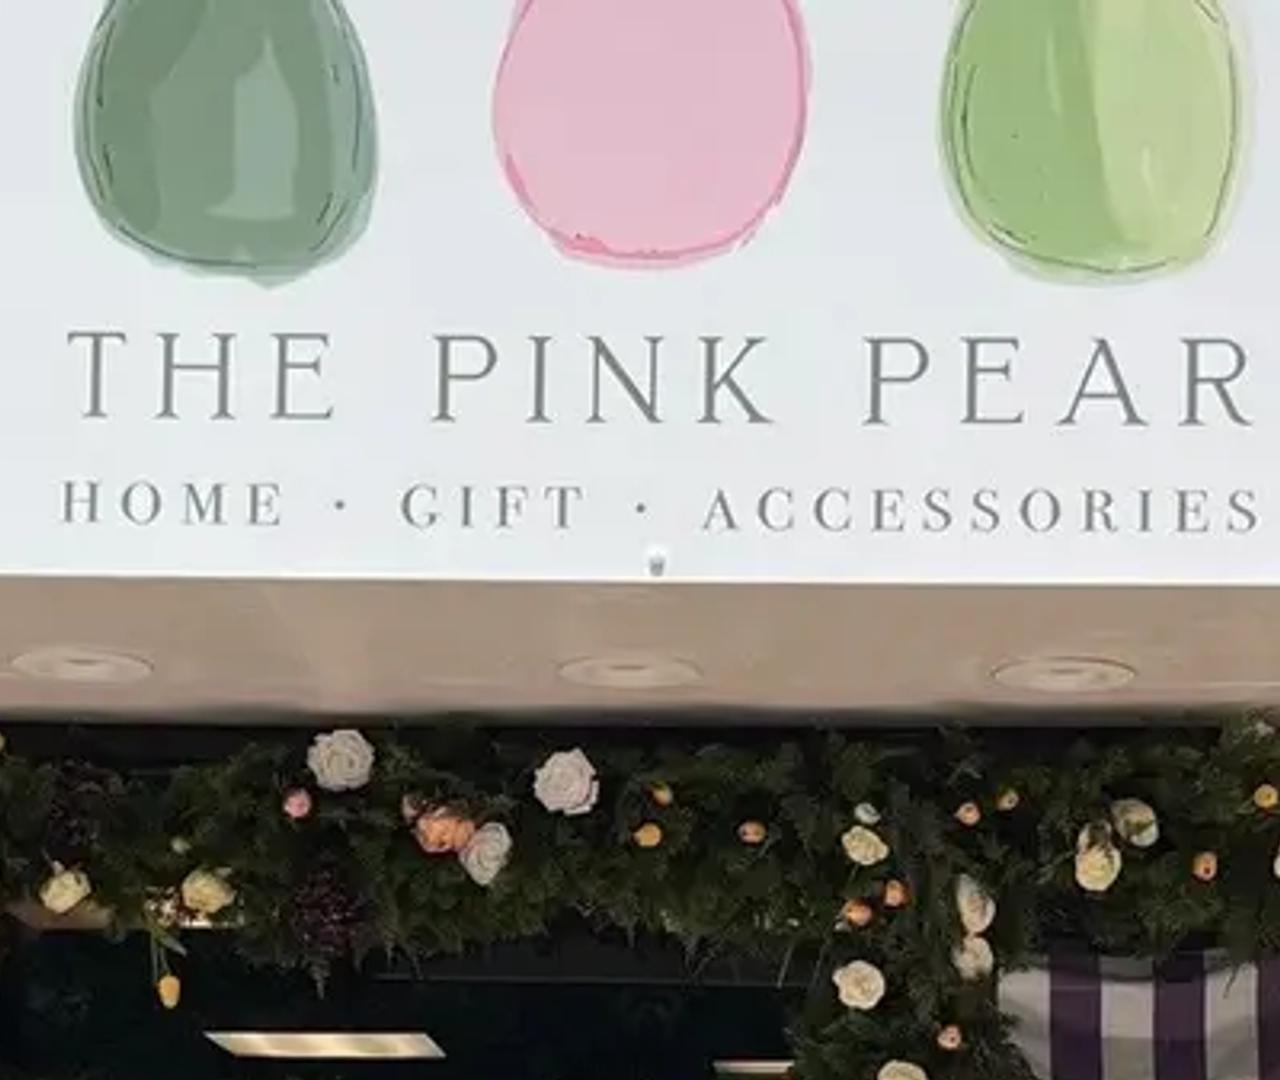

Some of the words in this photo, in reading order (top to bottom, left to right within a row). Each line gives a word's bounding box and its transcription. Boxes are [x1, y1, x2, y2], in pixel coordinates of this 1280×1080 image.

[66, 330, 334, 421] THE
[431, 333, 773, 425] PINK
[863, 335, 1254, 427] PEAR
[62, 480, 281, 527] HOME
[400, 484, 583, 531] GIFT
[702, 486, 1258, 534] ACCESSORIES
